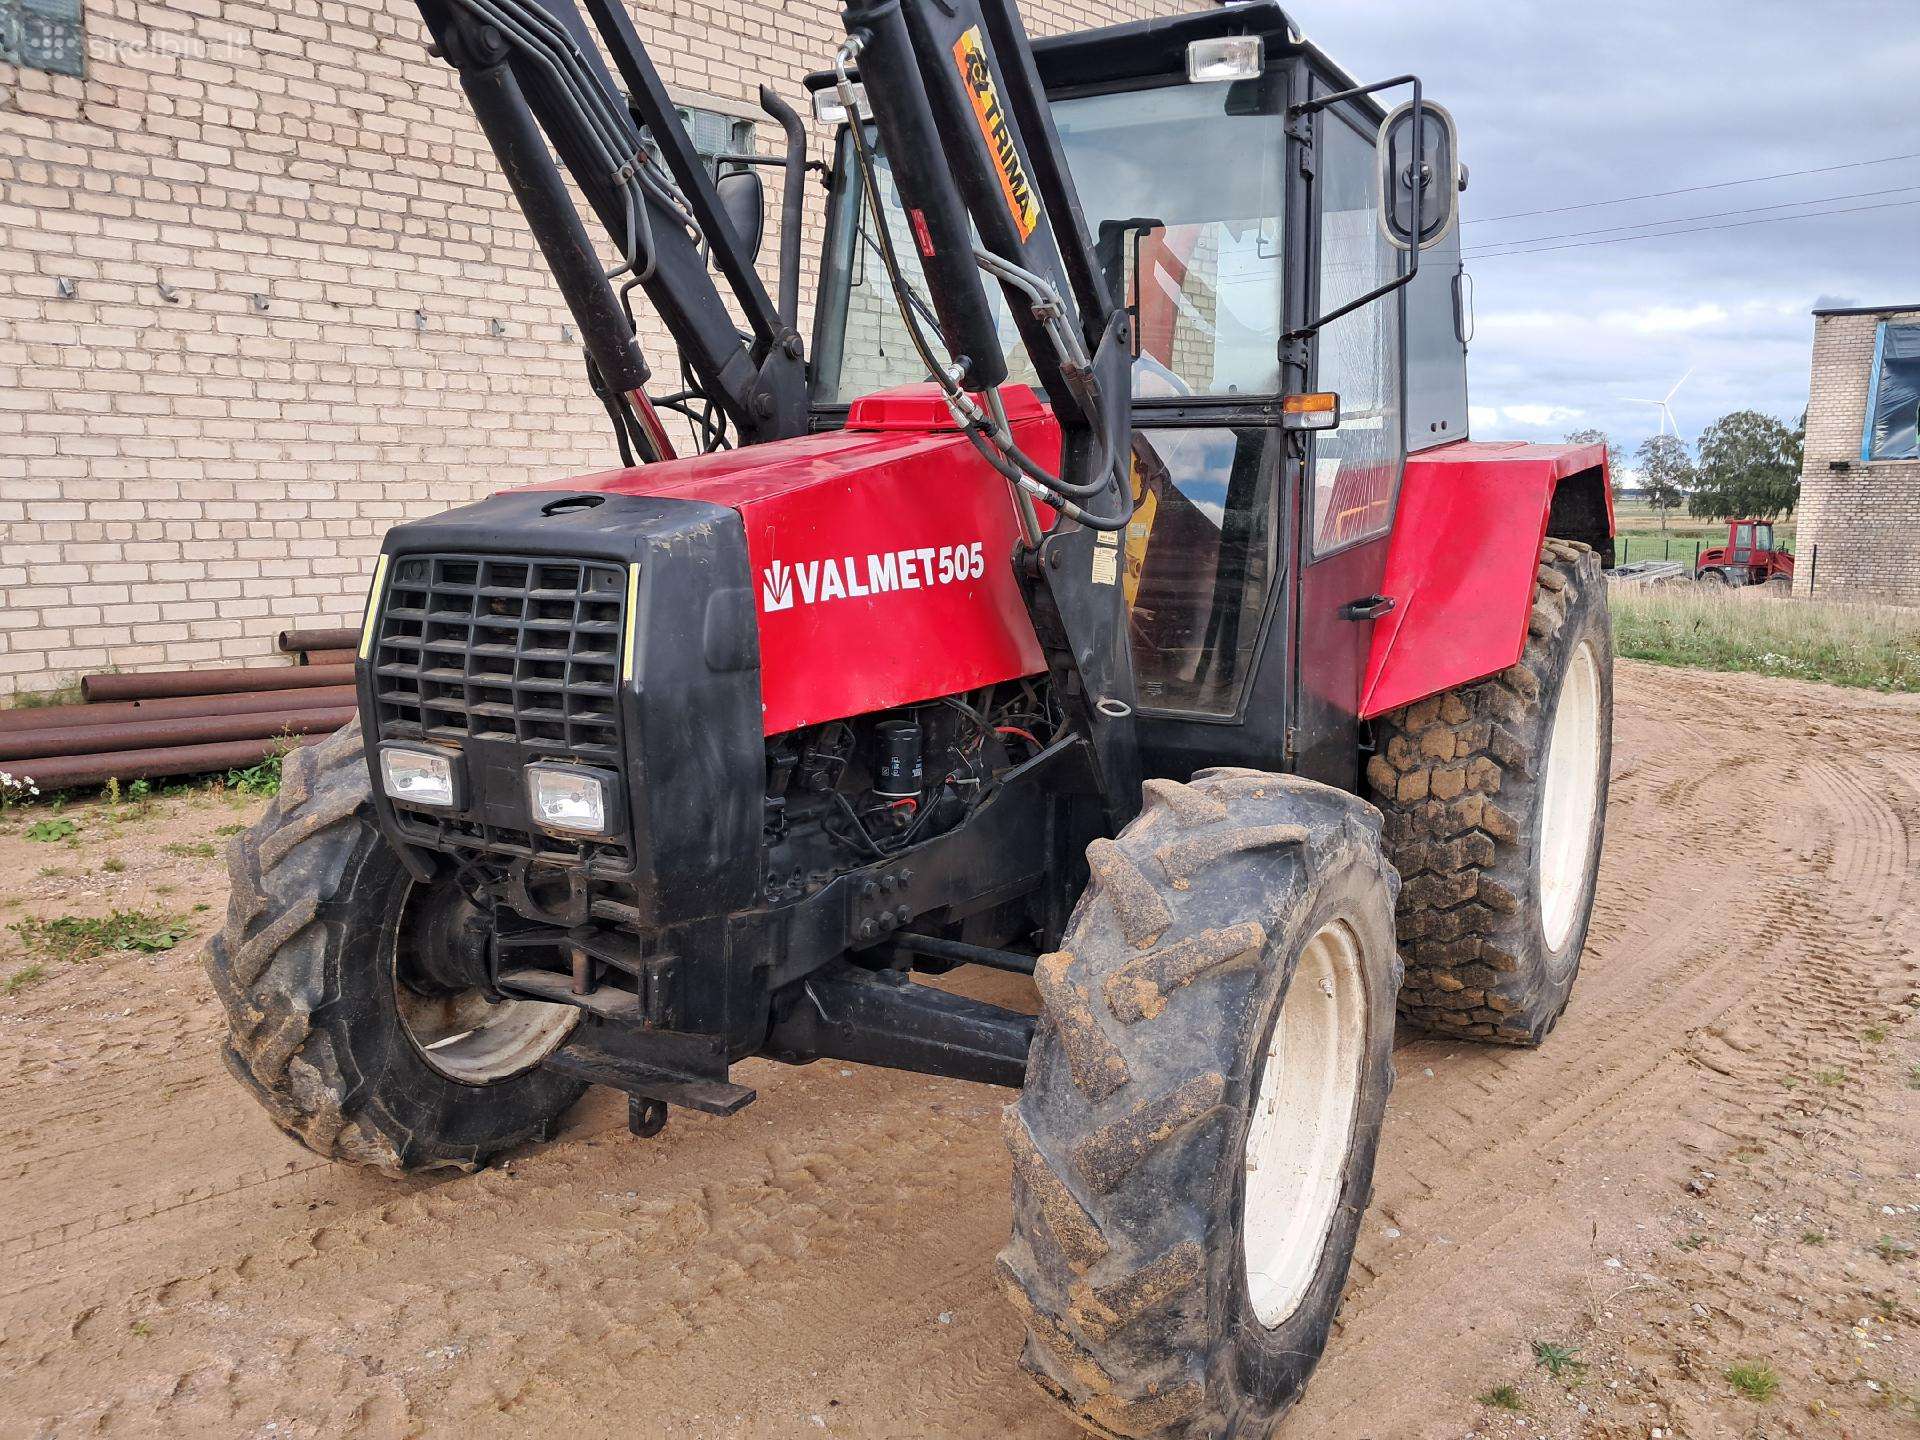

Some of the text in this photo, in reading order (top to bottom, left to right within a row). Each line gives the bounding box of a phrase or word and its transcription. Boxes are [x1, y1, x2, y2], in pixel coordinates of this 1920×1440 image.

[985, 93, 1030, 221] TRIMA
[795, 542, 984, 604] VALMET 505
